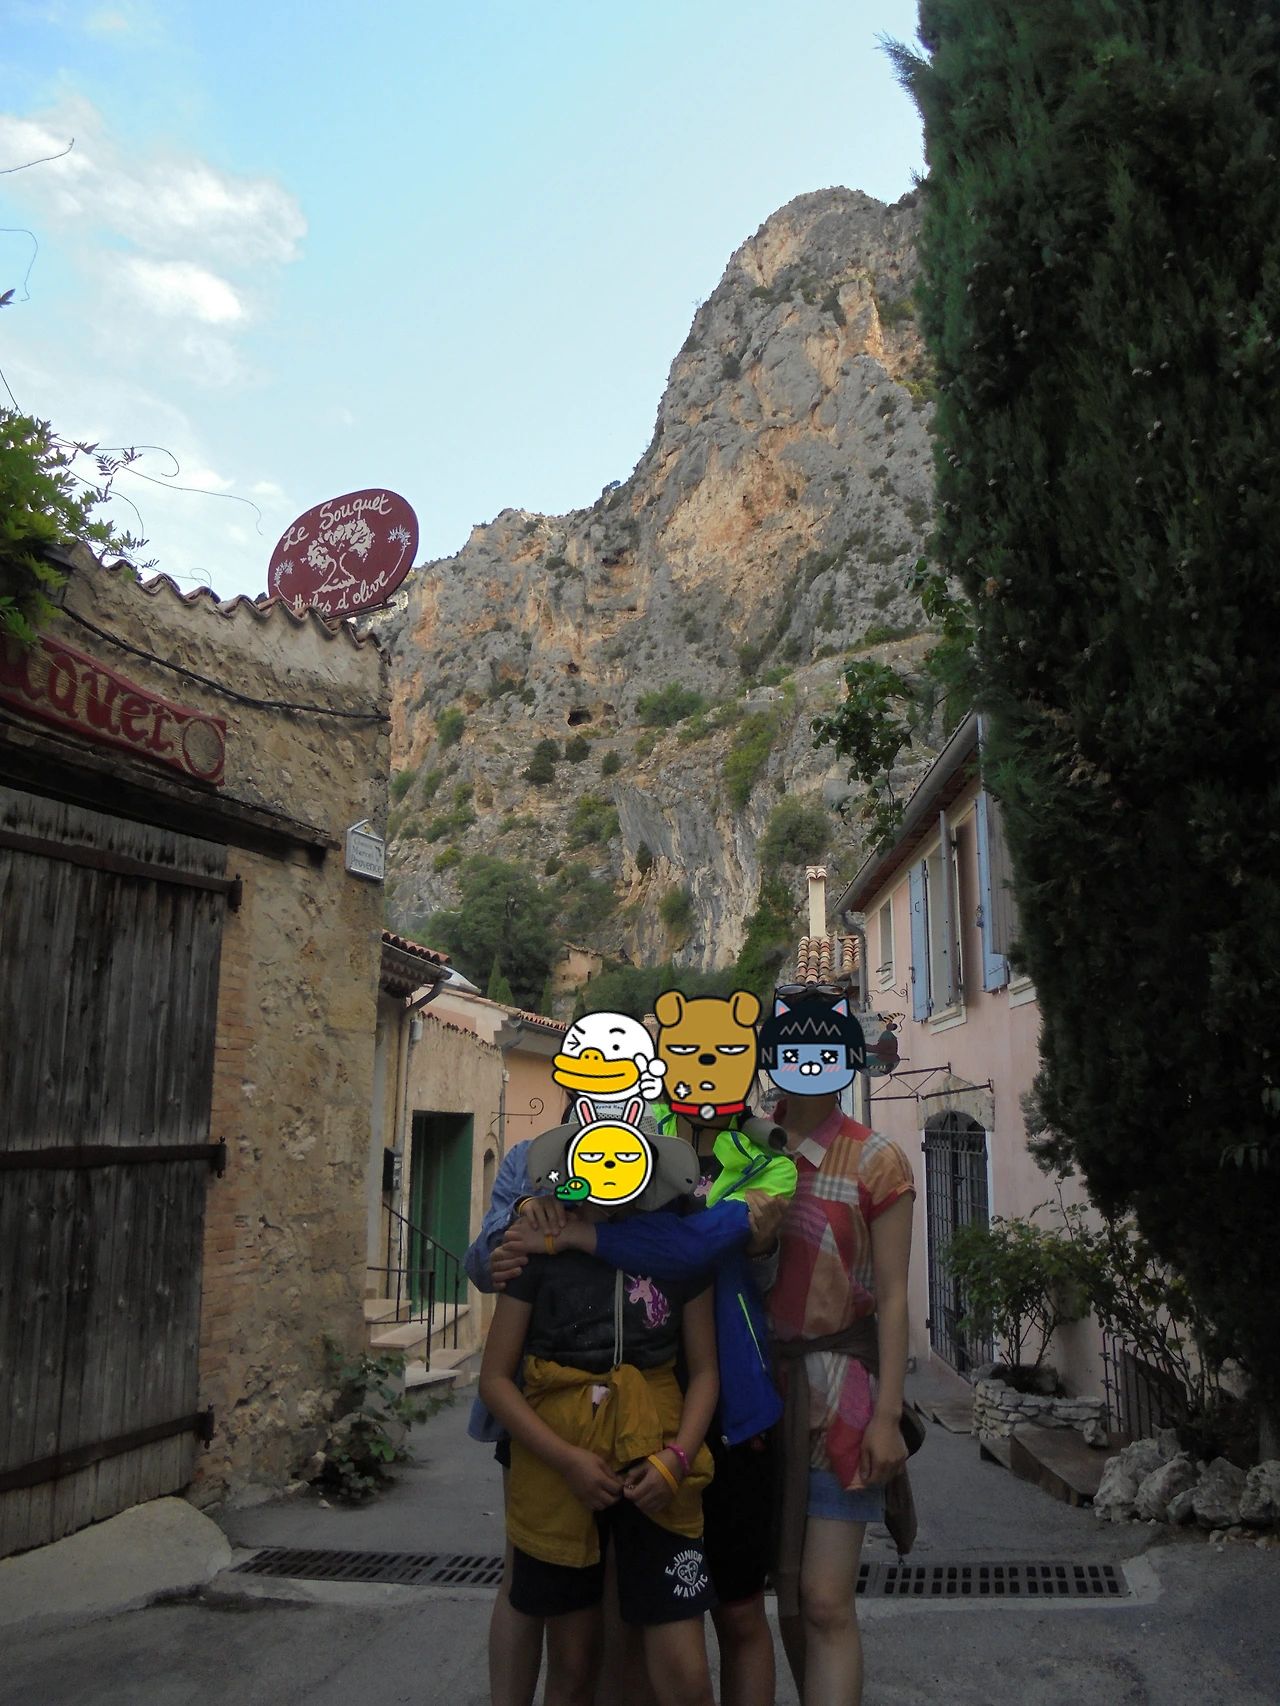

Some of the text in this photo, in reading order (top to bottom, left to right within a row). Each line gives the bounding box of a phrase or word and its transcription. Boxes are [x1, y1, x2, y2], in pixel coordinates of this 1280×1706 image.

[283, 493, 393, 551] Le Souquet
[352, 845, 374, 859] Marcel
[350, 854, 382, 873] Provence
[673, 1574, 708, 1598] NAUTIC
